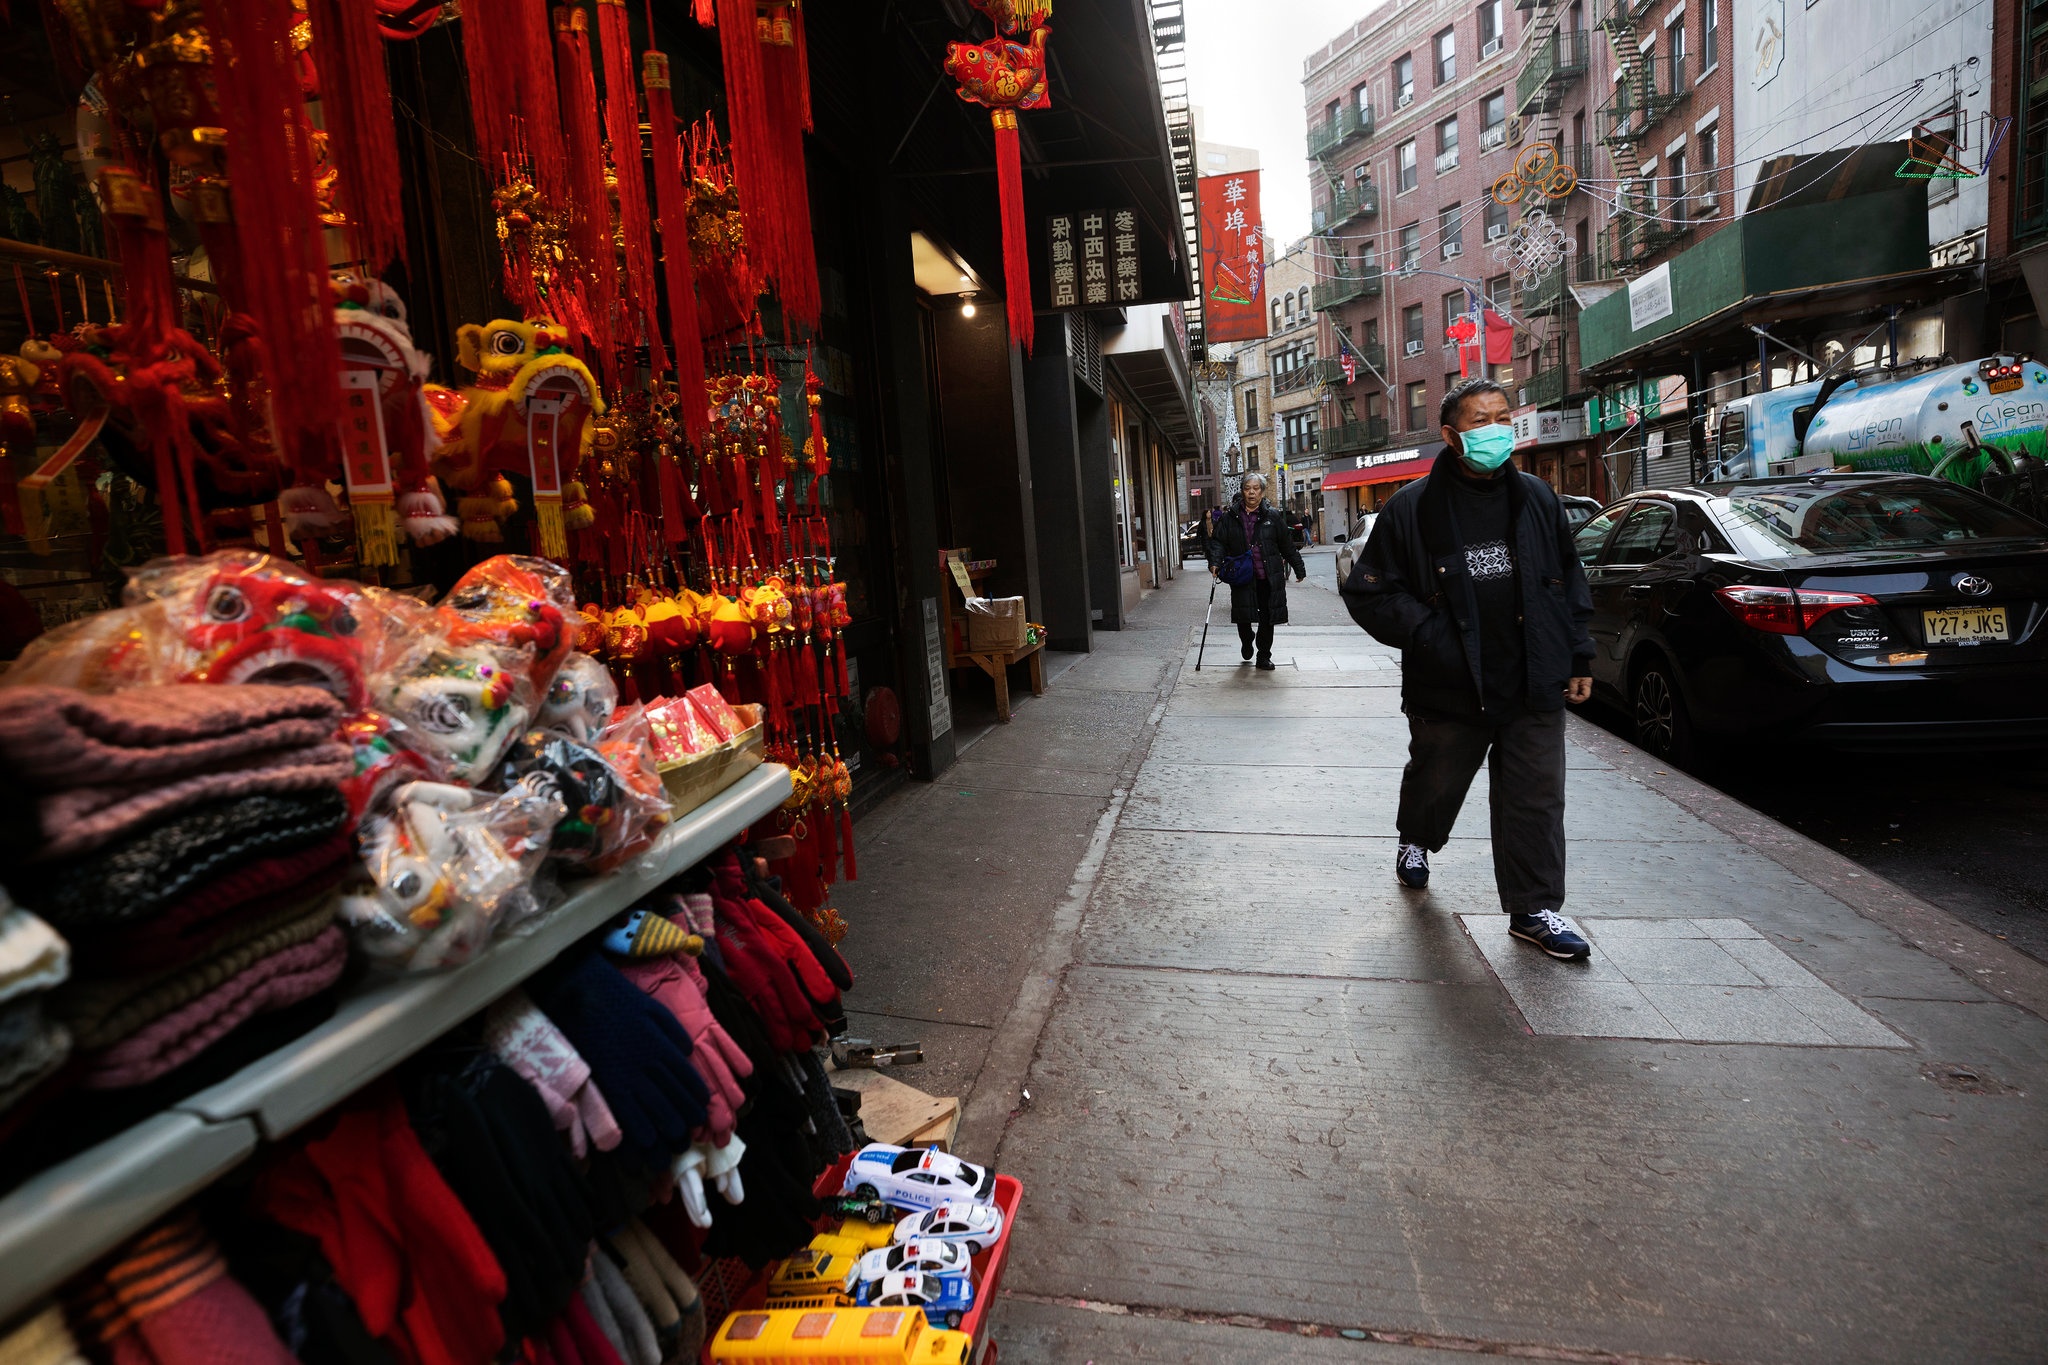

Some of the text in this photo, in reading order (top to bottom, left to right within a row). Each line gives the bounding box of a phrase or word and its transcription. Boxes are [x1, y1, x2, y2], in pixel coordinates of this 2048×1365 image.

[1222, 177, 1248, 237] 華埠
[1976, 402, 2044, 424] Clean
[1980, 412, 2016, 432] Air
[1849, 414, 1903, 440] Clean
[1373, 454, 1386, 465] EYE
[1385, 449, 1419, 462] SOLUTIONS
[1962, 608, 1986, 616] Jersey
[1928, 614, 2004, 636] Y27 JKS
[895, 1189, 931, 1203] POLICE
